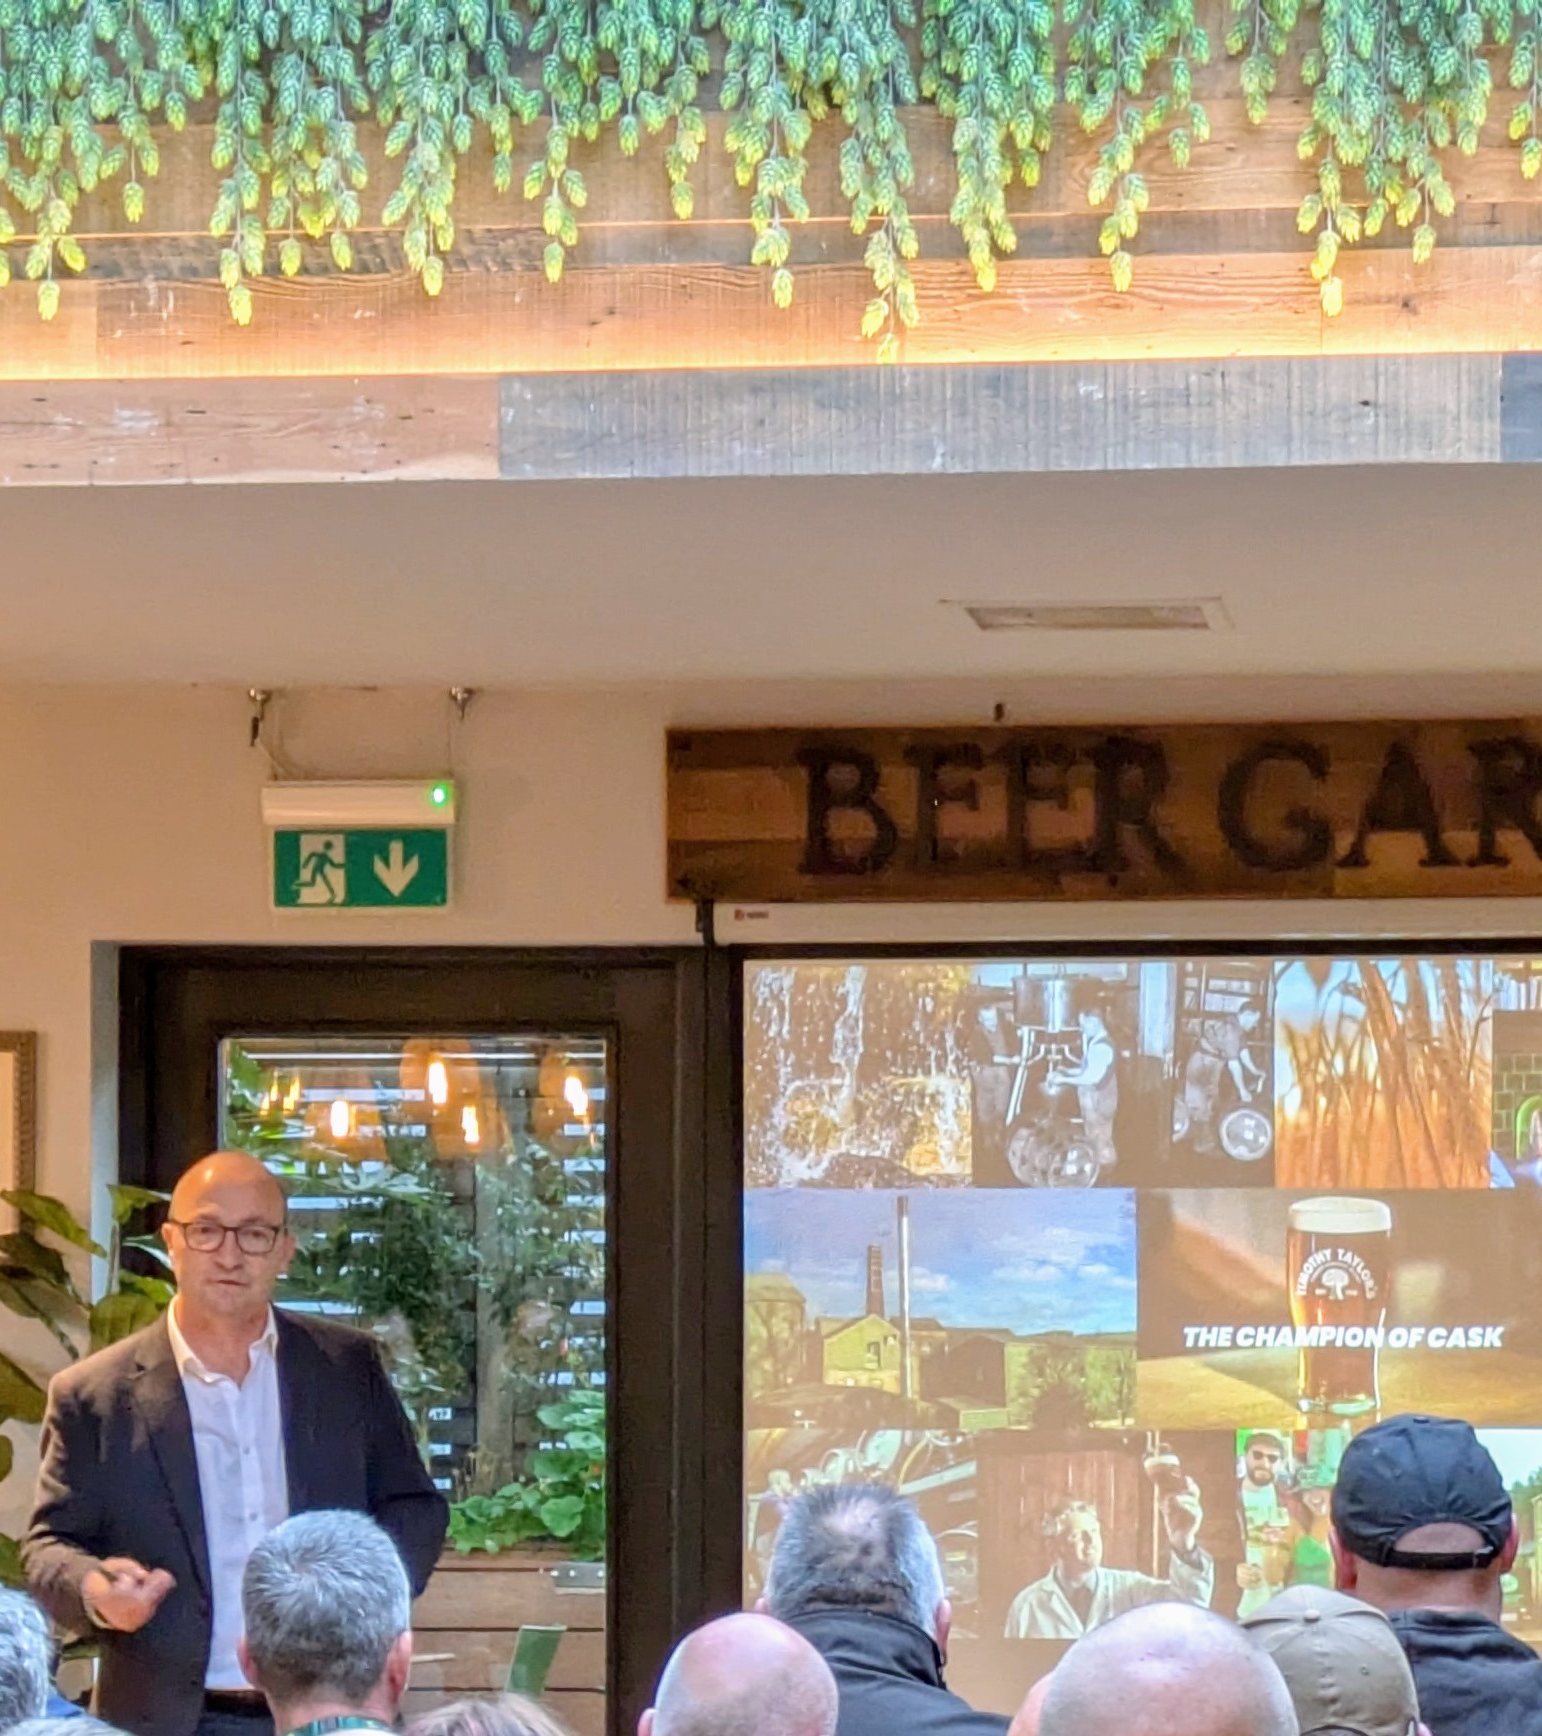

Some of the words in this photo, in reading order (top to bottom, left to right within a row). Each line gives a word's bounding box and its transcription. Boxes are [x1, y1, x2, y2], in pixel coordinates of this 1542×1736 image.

[796, 733, 1187, 878] BEER
[1183, 1326, 1235, 1348] THE
[1236, 1326, 1385, 1348] CHAMPION
[1388, 1327, 1425, 1348] OF
[1427, 1326, 1505, 1348] CASK
